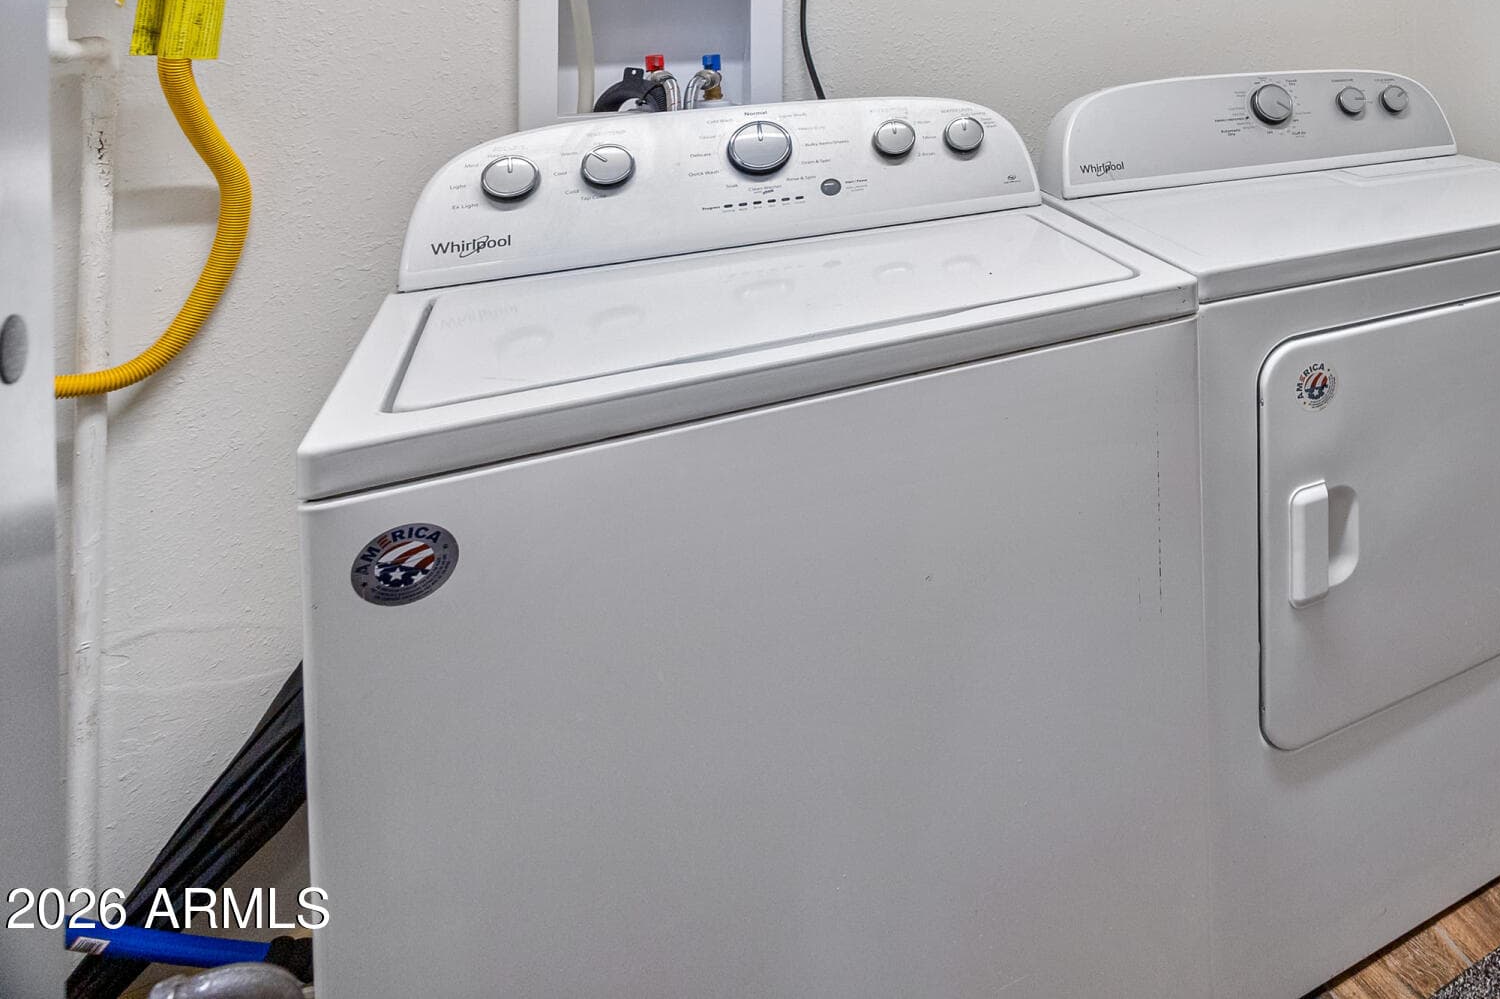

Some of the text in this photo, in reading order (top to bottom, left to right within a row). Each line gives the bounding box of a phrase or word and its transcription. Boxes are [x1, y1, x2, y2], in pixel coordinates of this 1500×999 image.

[1080, 161, 1125, 175] Whirlpool
[431, 234, 511, 256] Whirlpool
[355, 527, 442, 576] AMERICA
